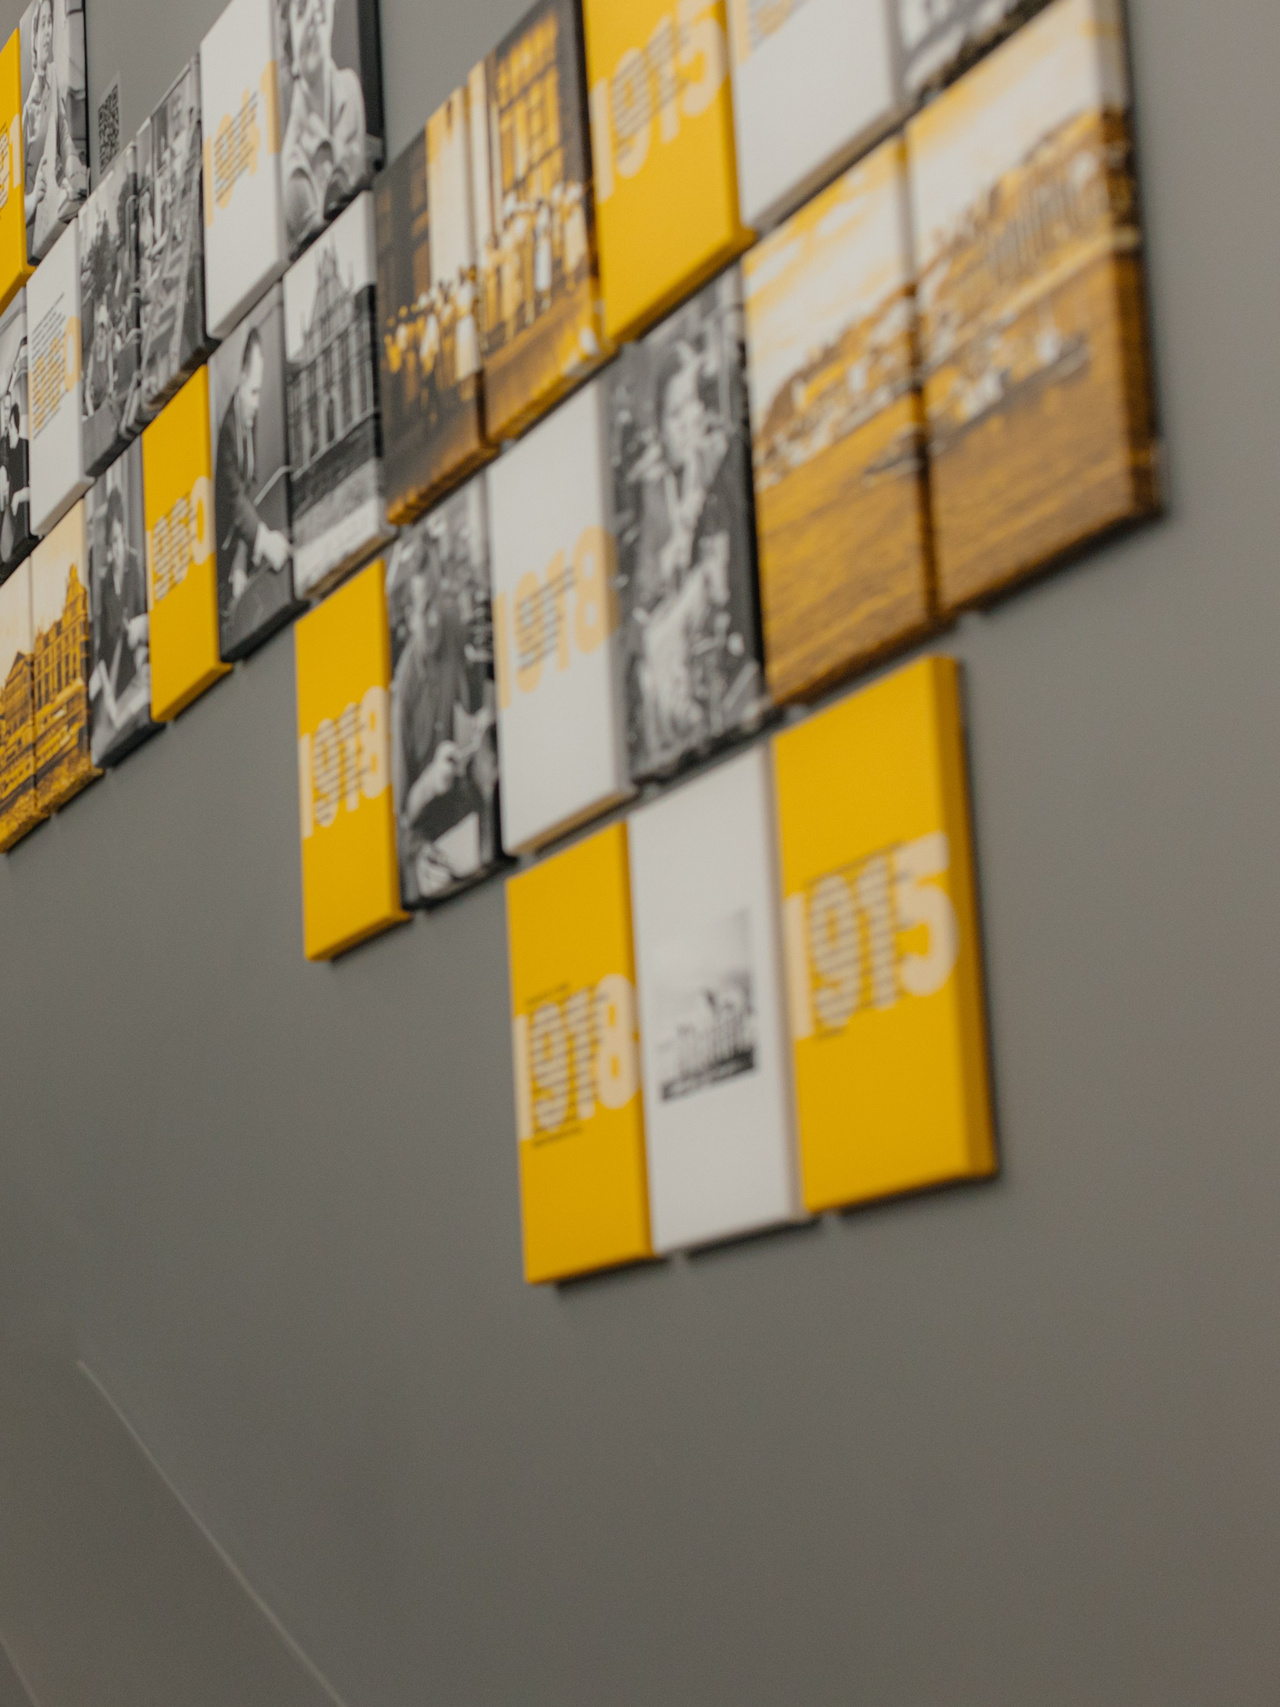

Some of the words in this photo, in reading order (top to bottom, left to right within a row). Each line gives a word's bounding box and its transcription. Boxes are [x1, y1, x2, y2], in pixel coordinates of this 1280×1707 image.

[589, 0, 727, 204] 1915
[492, 525, 618, 710] 1918
[785, 829, 959, 1040] 1915
[513, 973, 640, 1141] 1918
